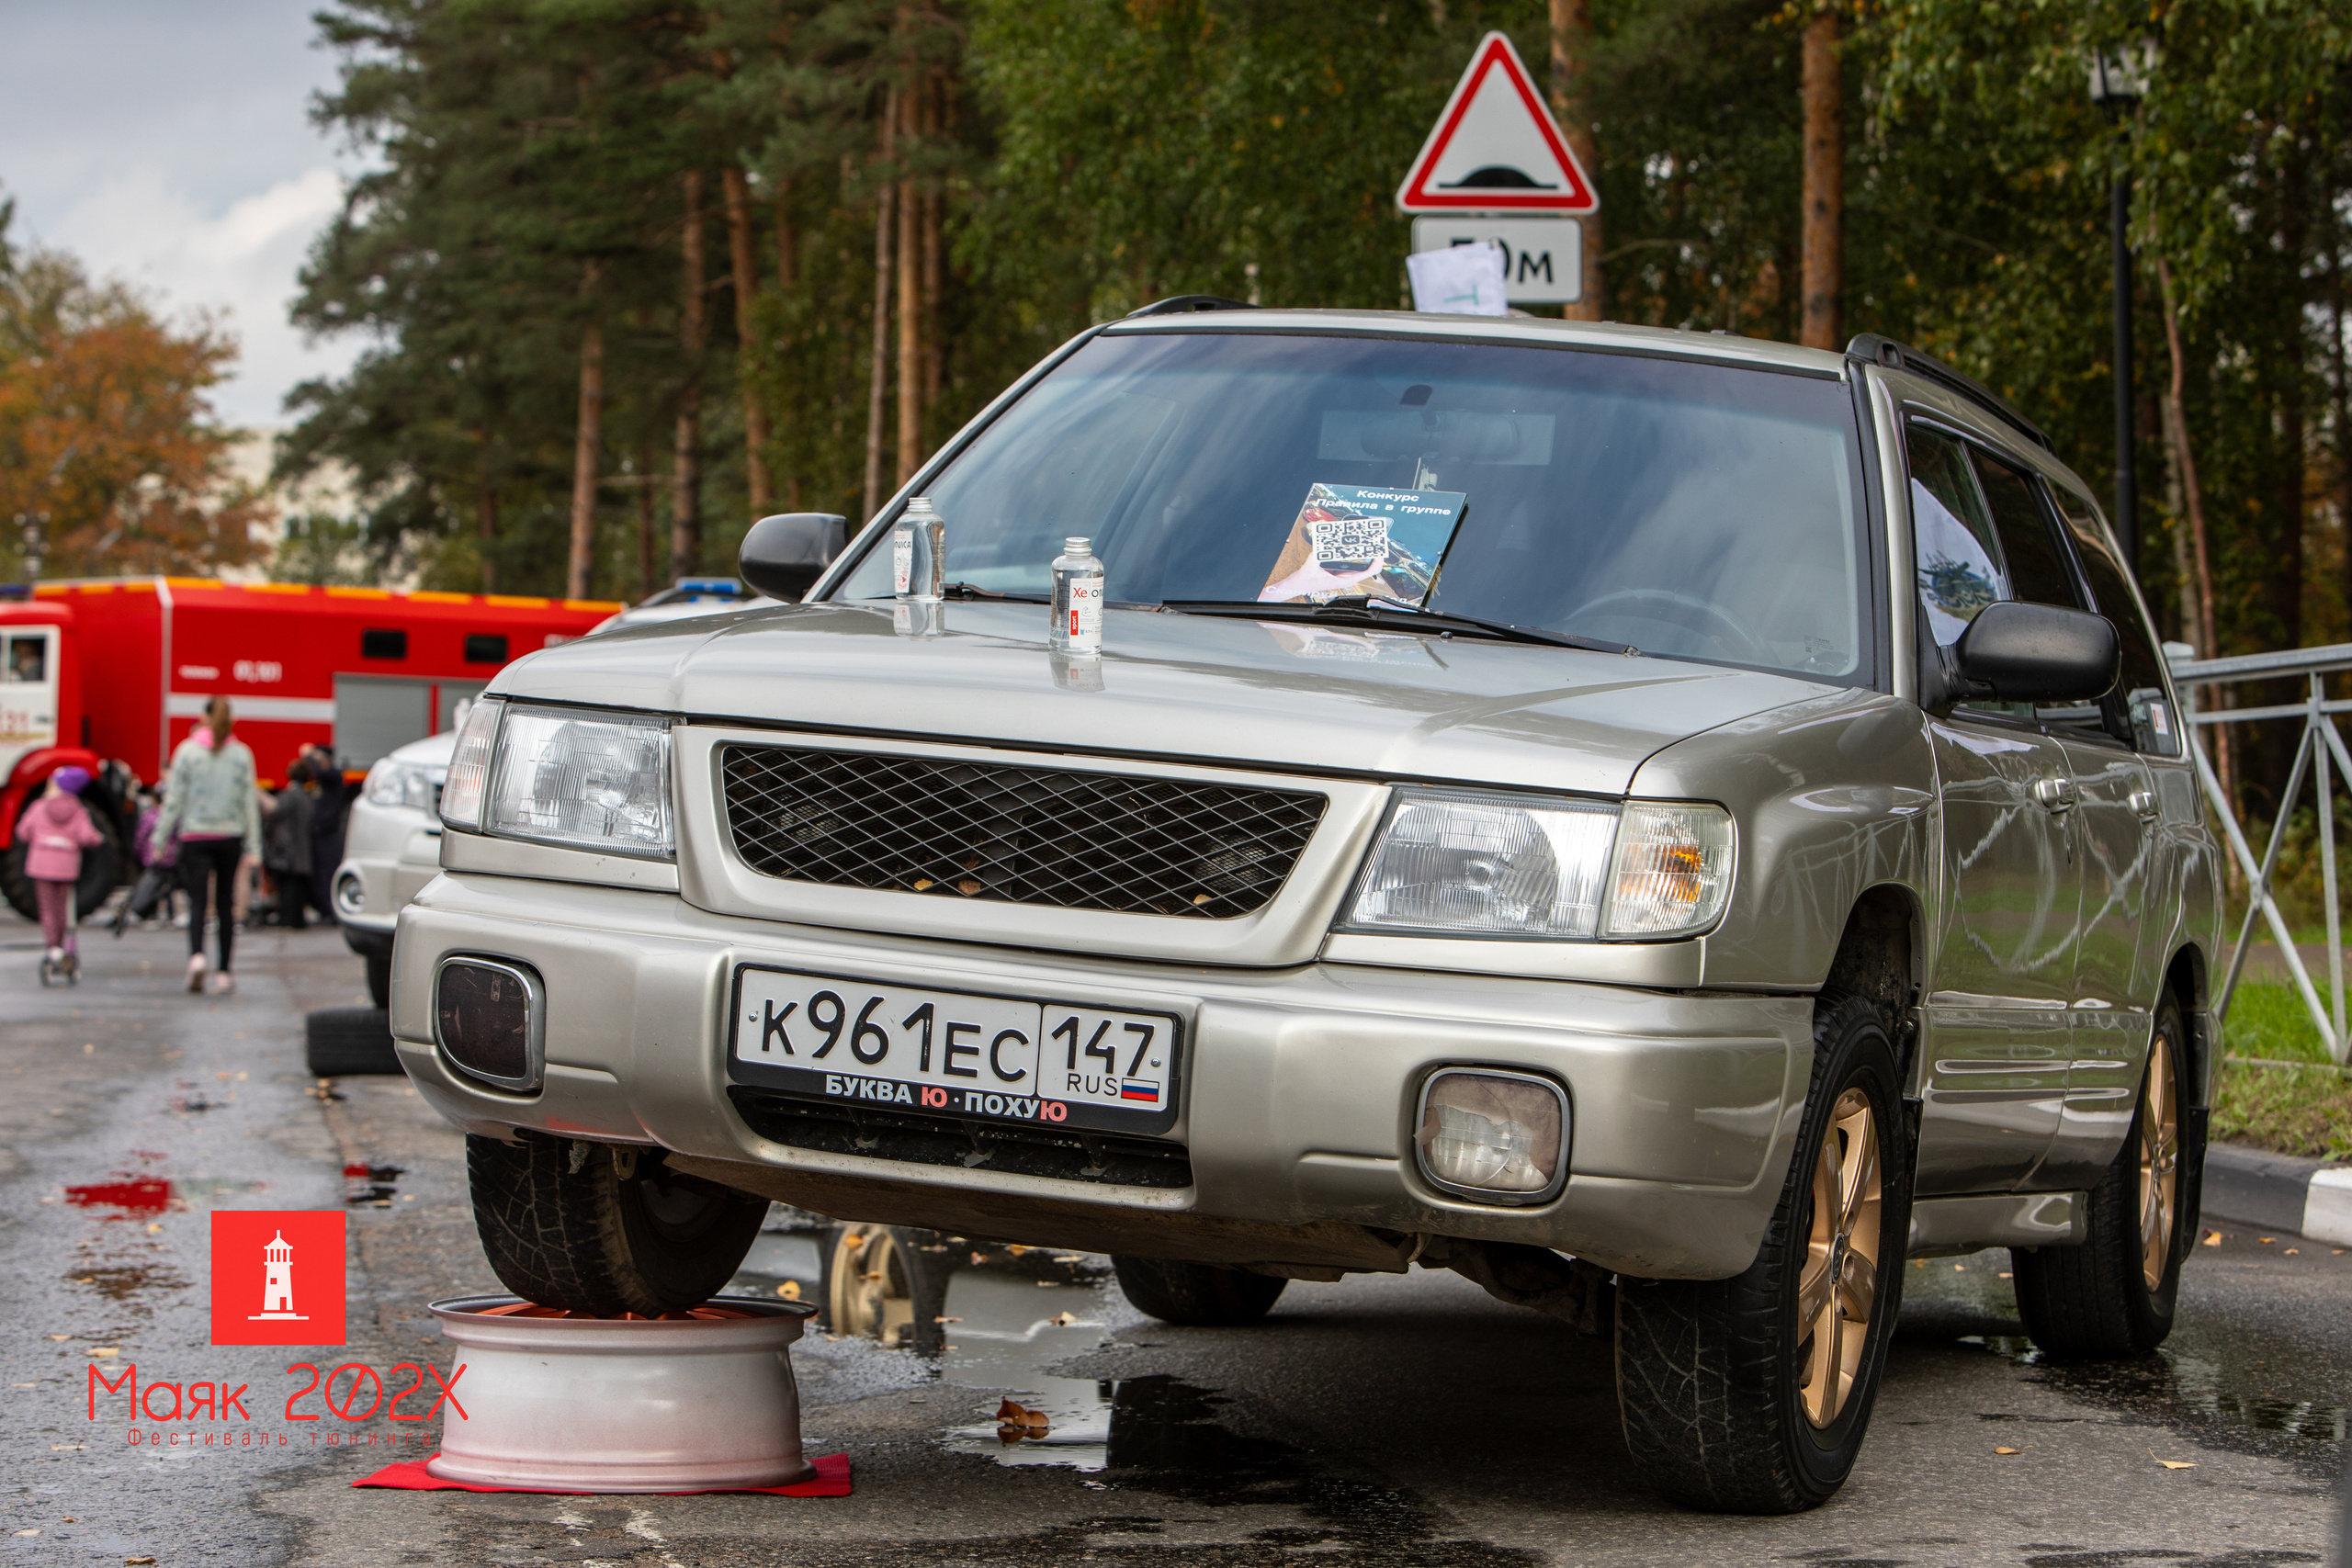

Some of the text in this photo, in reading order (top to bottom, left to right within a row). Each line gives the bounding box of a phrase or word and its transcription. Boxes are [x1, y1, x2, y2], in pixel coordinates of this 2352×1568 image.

[1315, 498, 1378, 510] Правила
[1401, 505, 1452, 515] группе
[1356, 490, 1419, 502] Конкурс
[1073, 587, 1088, 598] Xe
[1051, 1016, 1156, 1077] 147
[1067, 1073, 1119, 1098] RUS
[825, 1073, 1068, 1122] БУКВА Ю ПОХУЮ
